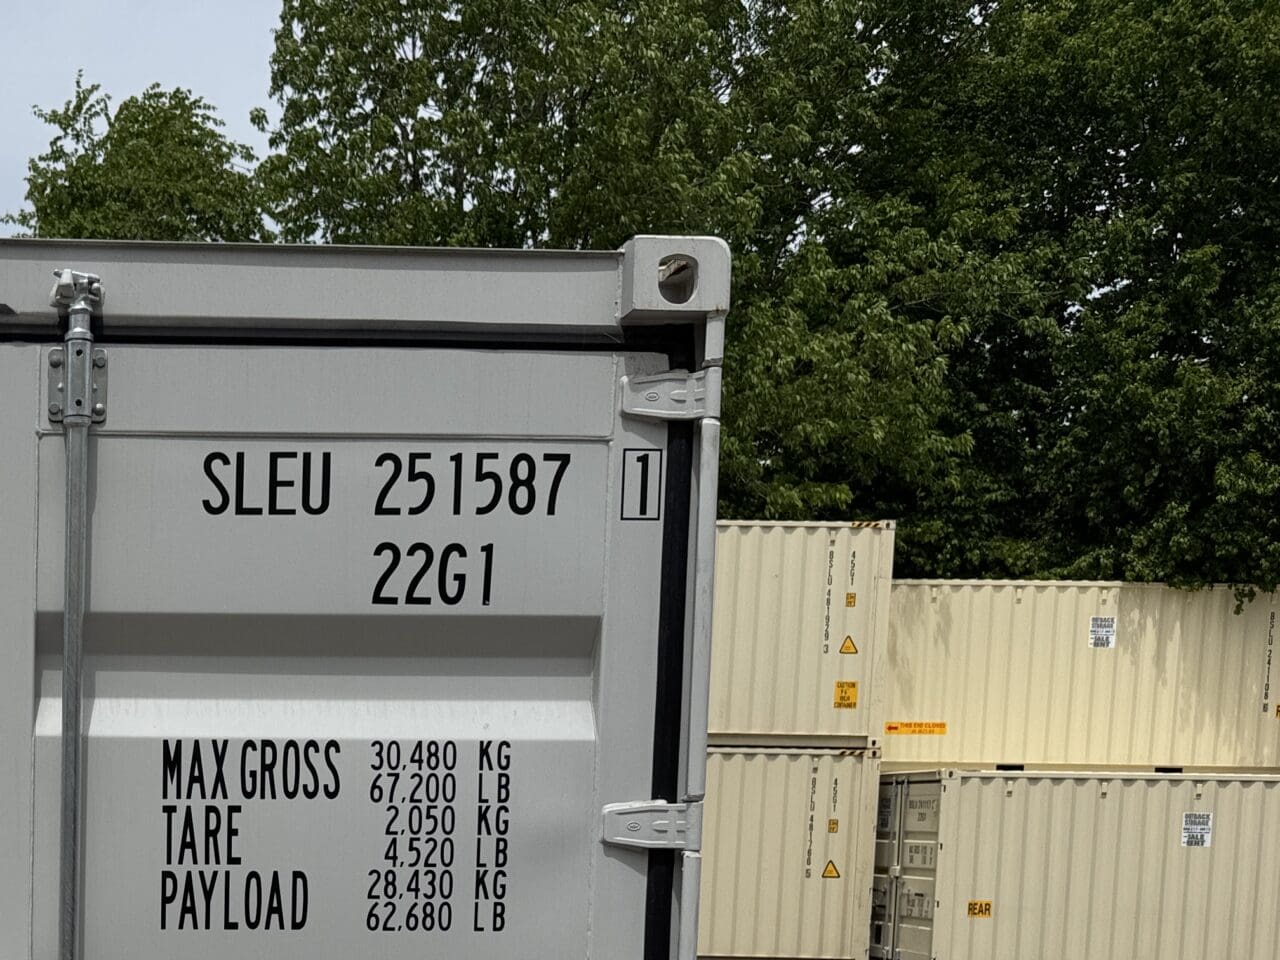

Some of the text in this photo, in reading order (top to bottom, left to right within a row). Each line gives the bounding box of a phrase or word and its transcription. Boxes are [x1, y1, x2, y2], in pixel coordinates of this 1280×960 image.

[201, 451, 650, 517] SLEU 251587 1
[372, 541, 494, 606] 22G1
[162, 739, 511, 800] MAX GROSS 30,480 KG
[370, 773, 510, 804] 67,200 LB
[162, 805, 509, 865] TARE 2,050 KG
[384, 837, 508, 868] 4,520 LB
[160, 869, 507, 930] PAYLOAD 28,430 KG
[366, 901, 505, 932] 62,680 LB
[967, 902, 992, 916] REAR
